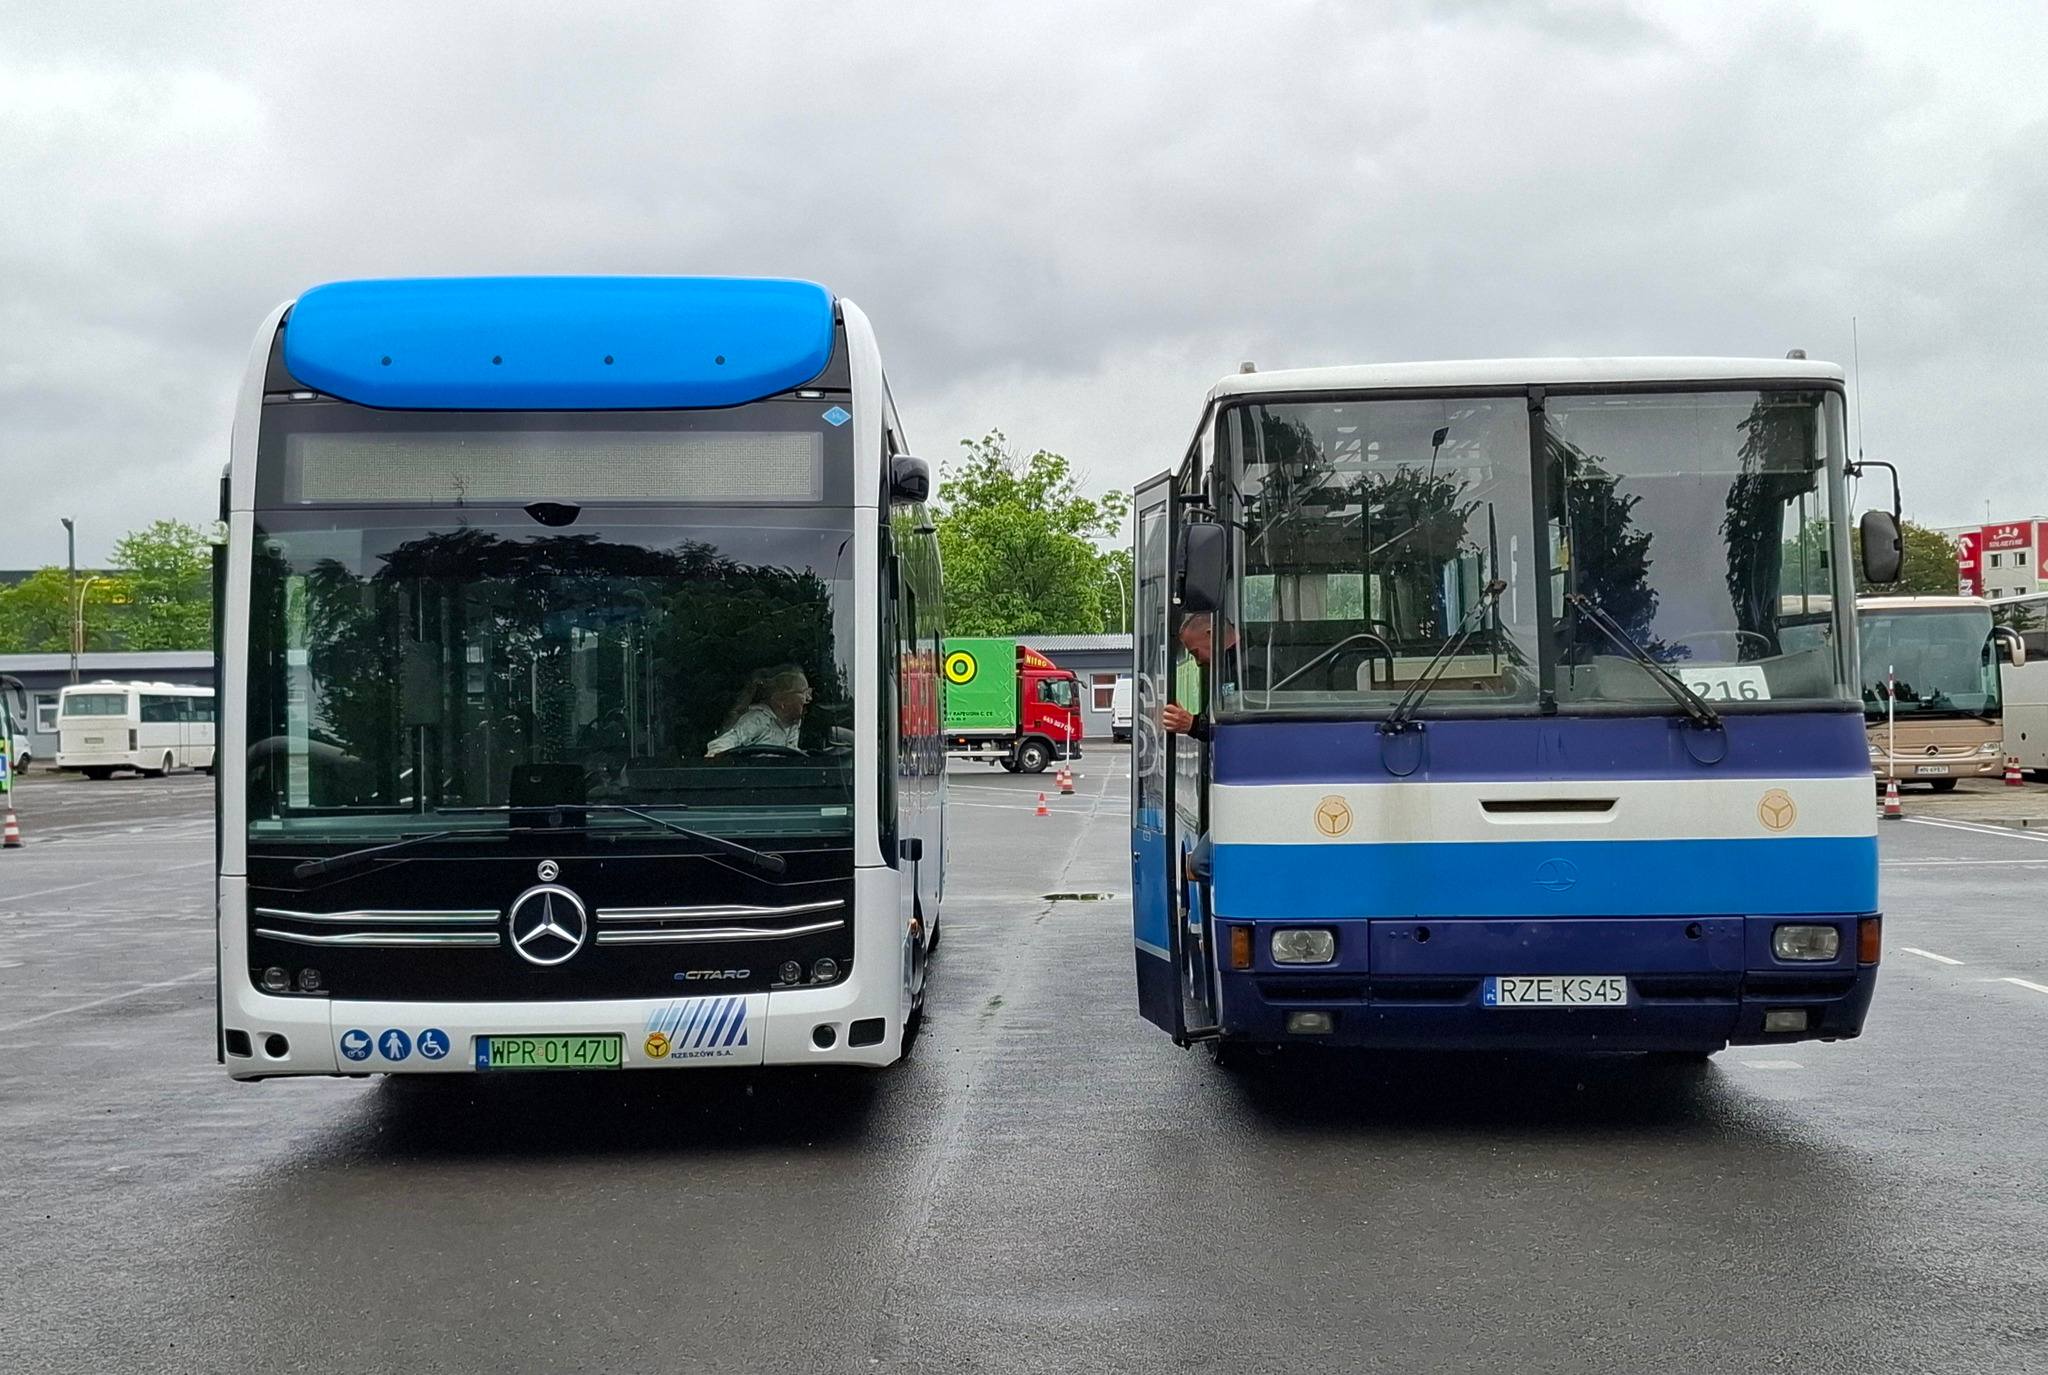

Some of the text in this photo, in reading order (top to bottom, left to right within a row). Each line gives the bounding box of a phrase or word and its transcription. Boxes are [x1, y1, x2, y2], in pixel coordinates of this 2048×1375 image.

[1693, 680, 1760, 700] 216
[673, 969, 751, 981] eCITARO
[1501, 979, 1553, 1003] RZE
[1561, 979, 1622, 1003] KS45
[491, 1040, 536, 1064] WPR
[545, 1040, 618, 1064] 0147U
[671, 1050, 716, 1059] RZESZÓW
